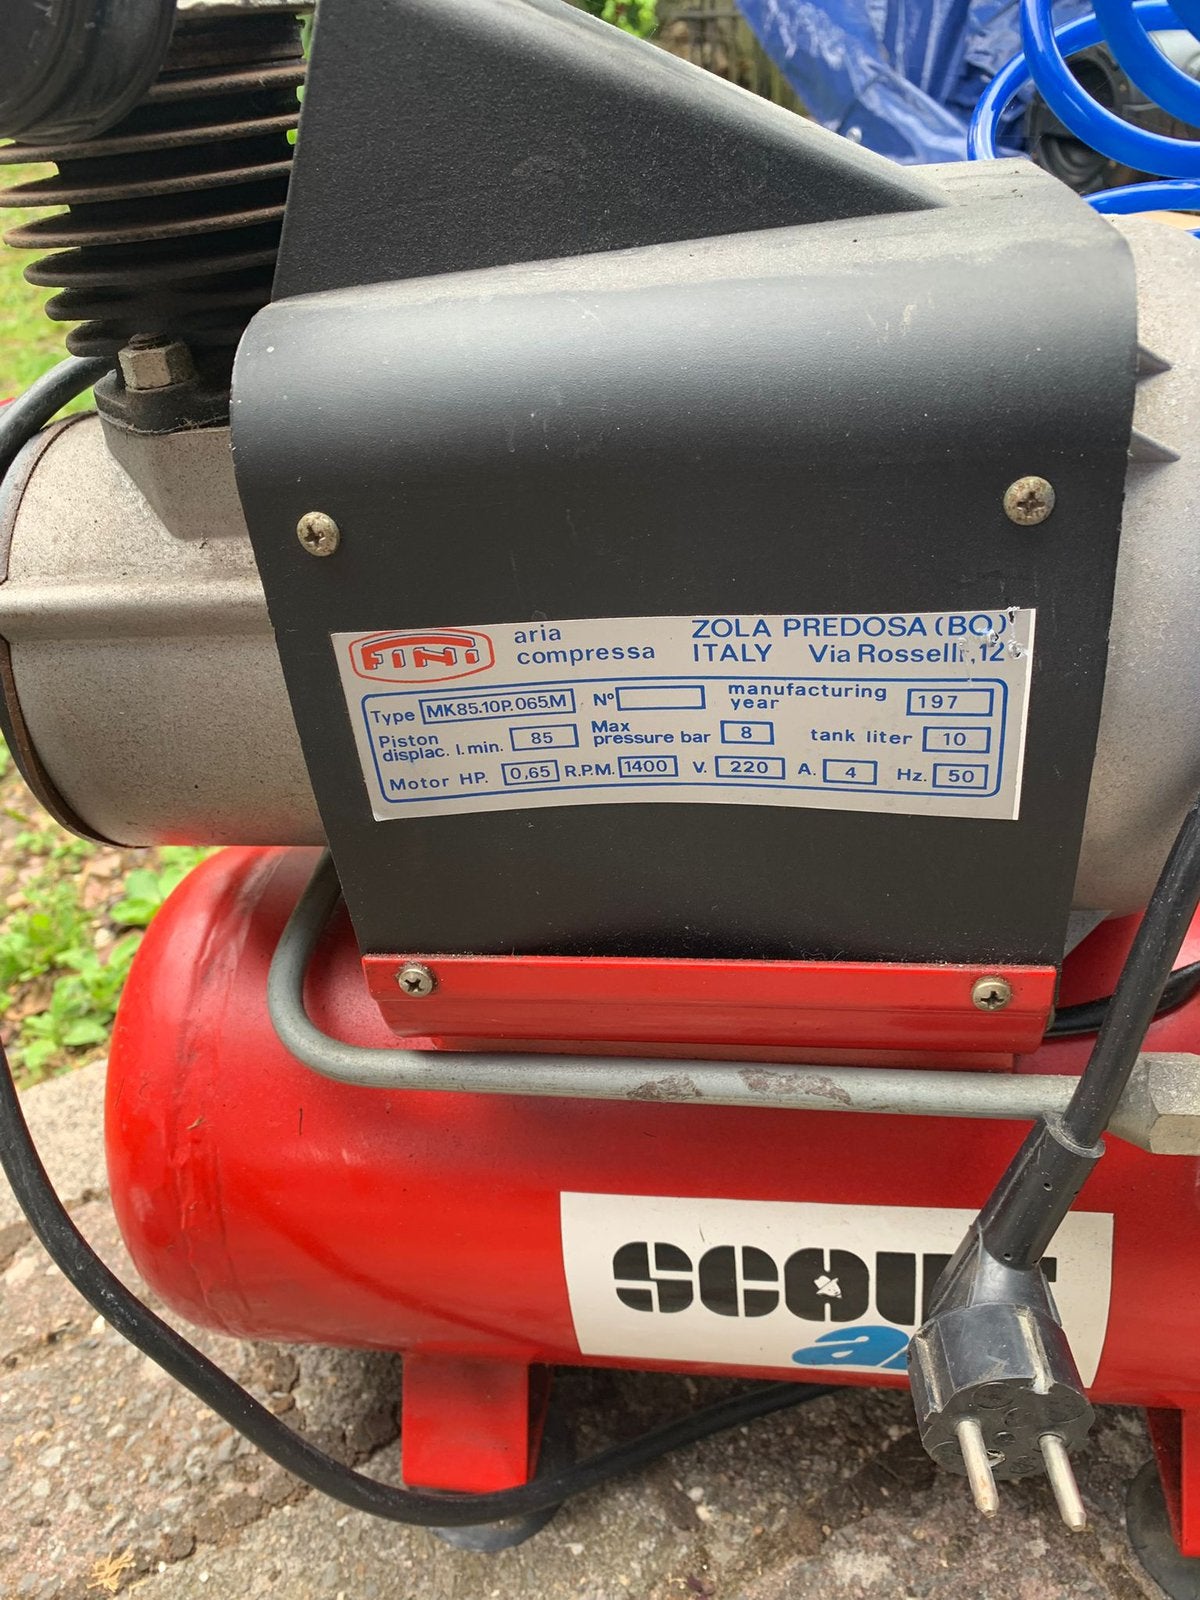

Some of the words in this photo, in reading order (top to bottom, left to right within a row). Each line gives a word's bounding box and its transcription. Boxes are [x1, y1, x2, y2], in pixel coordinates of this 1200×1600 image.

[514, 625, 561, 644] aria
[691, 619, 772, 638] ZOLA
[783, 617, 927, 638] PREDOSA
[935, 614, 1007, 637] (BO)
[360, 633, 480, 670] FINI
[517, 643, 655, 666] compressa
[693, 644, 773, 662] ITALY
[809, 644, 851, 663] Via
[728, 683, 888, 701] manufacturing
[731, 698, 780, 710] year
[918, 695, 958, 709] 197
[370, 710, 415, 725] Type
[591, 720, 630, 733] Max
[379, 734, 439, 749] Piston
[593, 732, 673, 747] pressure
[681, 731, 710, 744] bar
[740, 727, 752, 739] 8
[811, 729, 855, 743] tank
[866, 731, 913, 745] liter
[943, 732, 966, 746] 10
[383, 746, 449, 762] displac.
[531, 732, 553, 745] 85
[390, 775, 449, 791] Motor
[460, 772, 488, 785] HP.
[565, 763, 615, 777] R.P.M.
[625, 760, 667, 773] 1400
[693, 762, 707, 773] V.
[730, 761, 769, 774] 220
[798, 763, 816, 776] A.
[845, 767, 856, 779] 4
[897, 769, 927, 782] Hz.
[948, 770, 975, 783] 50
[613, 1241, 1057, 1325] SCOU
